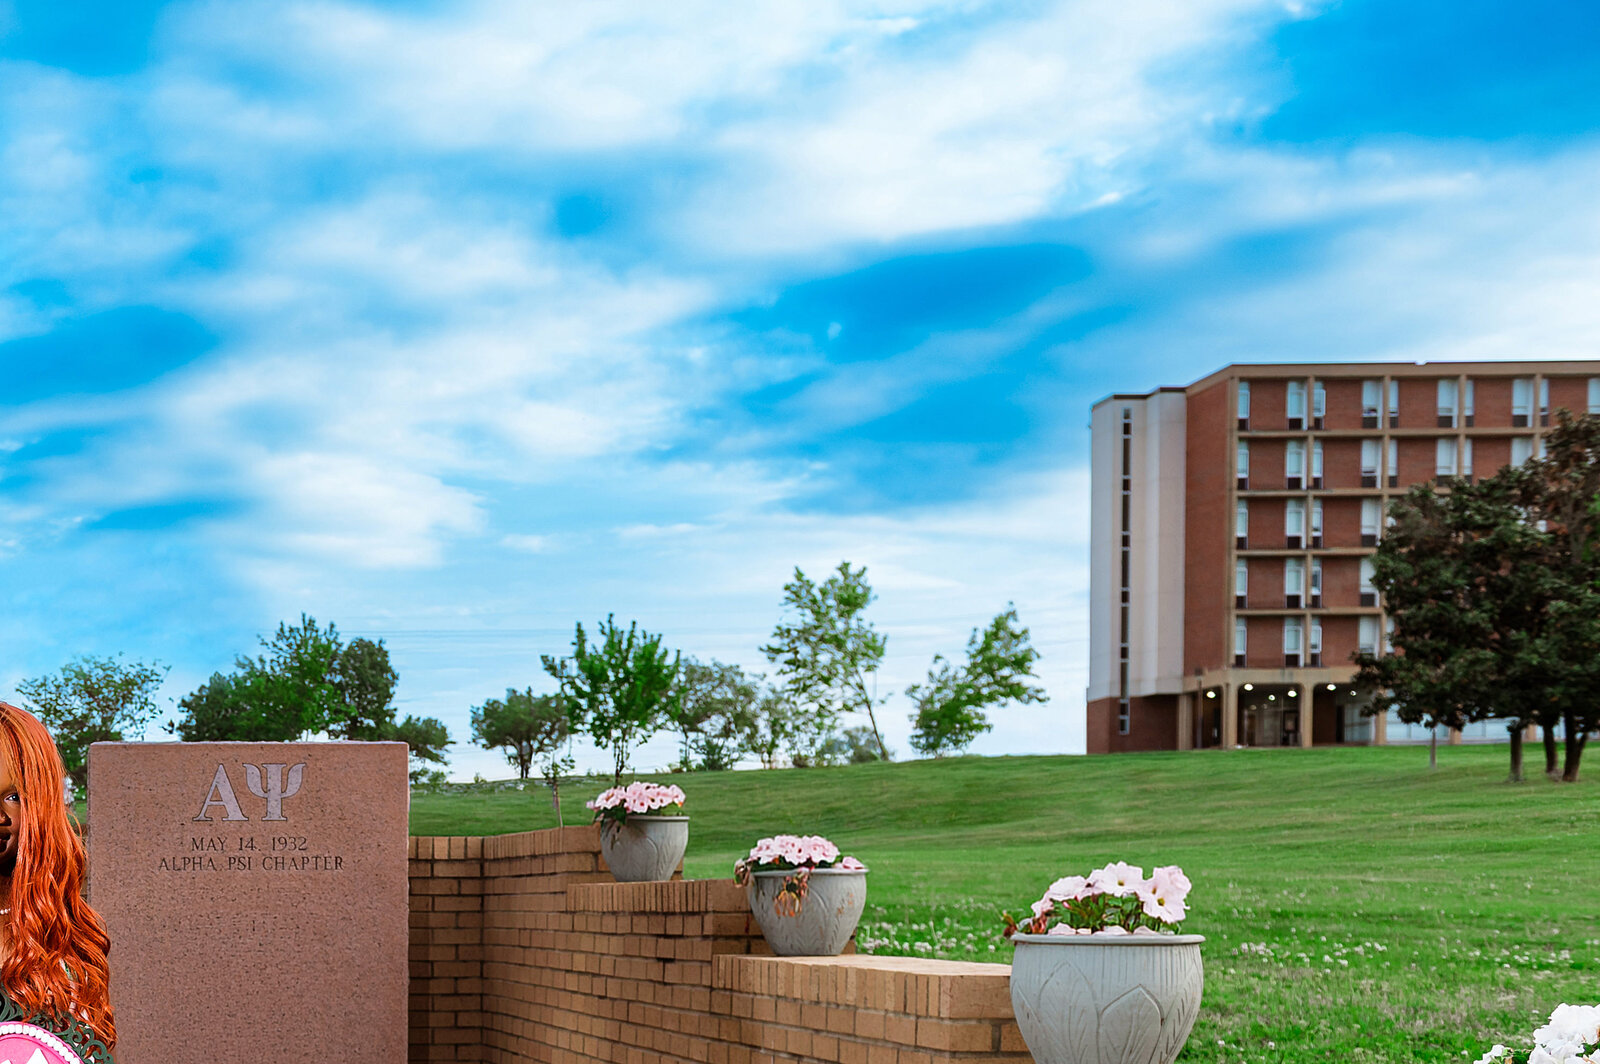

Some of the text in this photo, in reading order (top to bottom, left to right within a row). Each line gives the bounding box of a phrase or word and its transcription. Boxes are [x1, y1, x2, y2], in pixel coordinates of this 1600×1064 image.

[191, 837, 228, 852] MAY
[271, 837, 308, 852] 1932
[158, 856, 345, 871] ALPHA PSI CHAPTER
